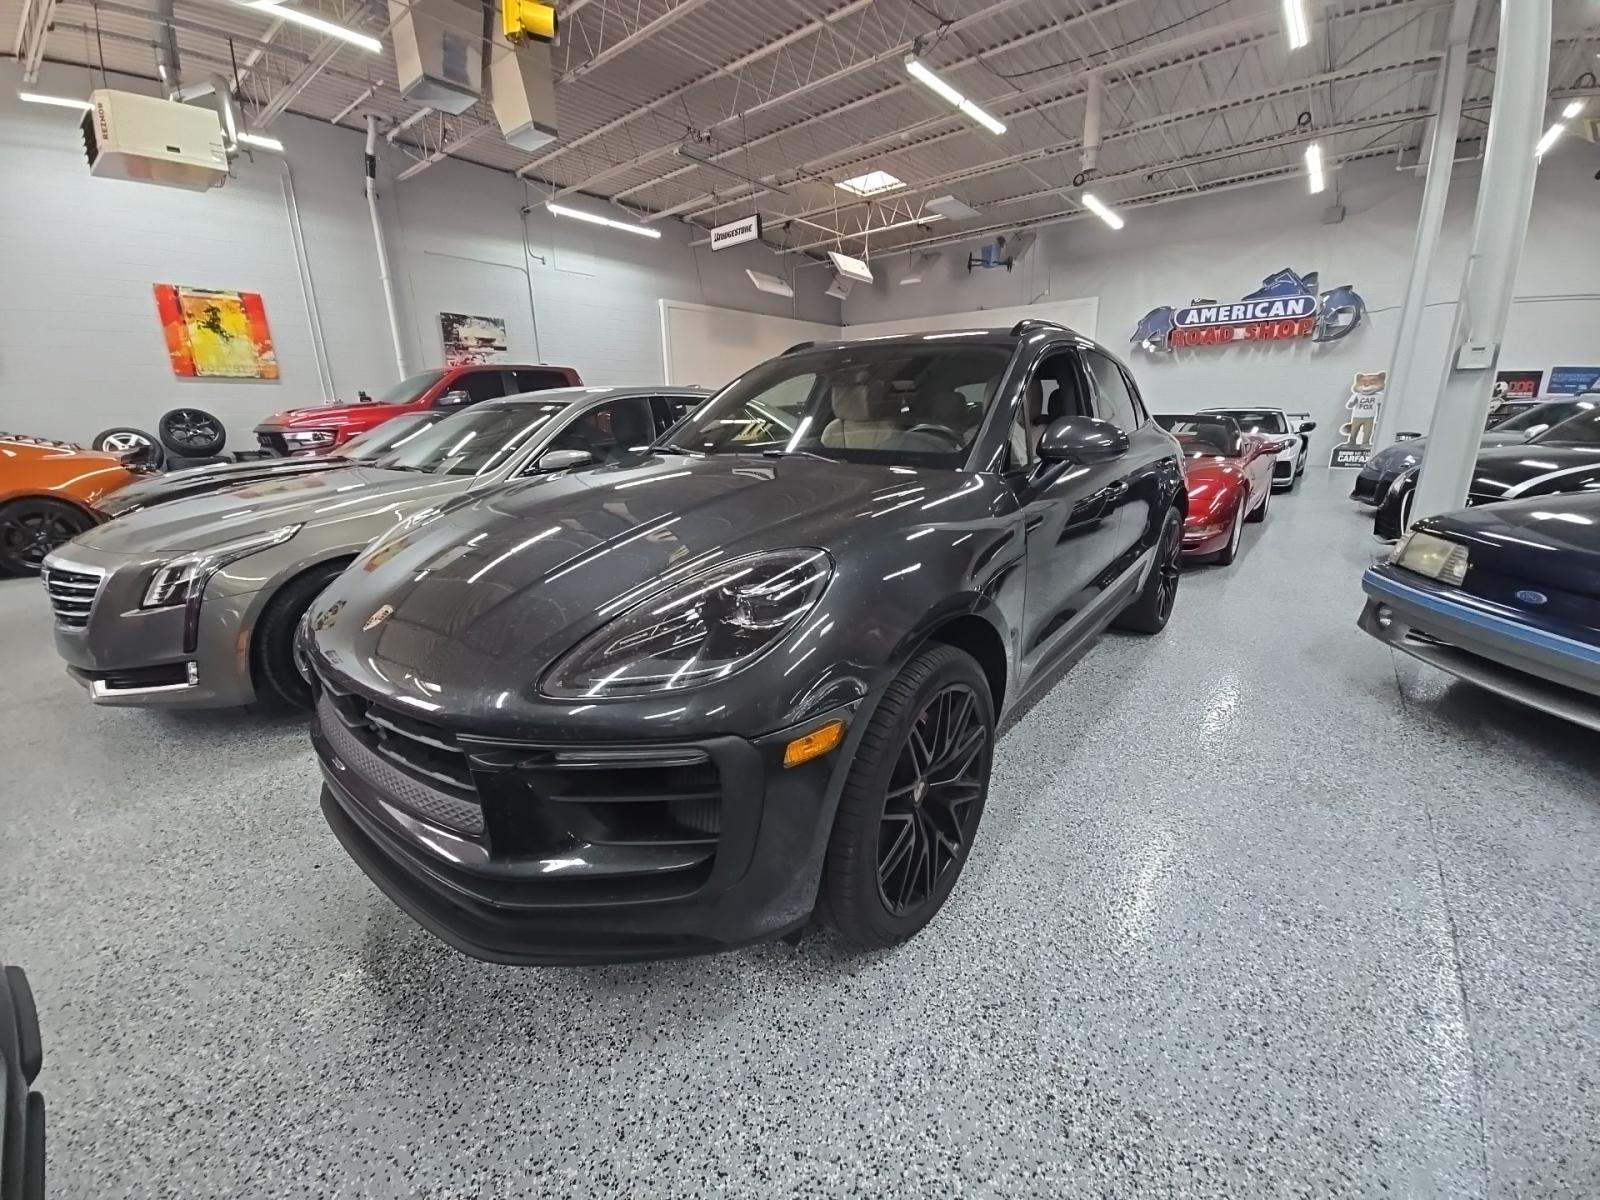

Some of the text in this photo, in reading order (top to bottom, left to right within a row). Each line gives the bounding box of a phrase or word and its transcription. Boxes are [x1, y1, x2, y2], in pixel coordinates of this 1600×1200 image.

[97, 102, 108, 140] REZNOR
[714, 224, 752, 242] BRIDGESTONE
[1184, 299, 1304, 324] AMERICAN
[1171, 319, 1315, 346] ROAD SHOP
